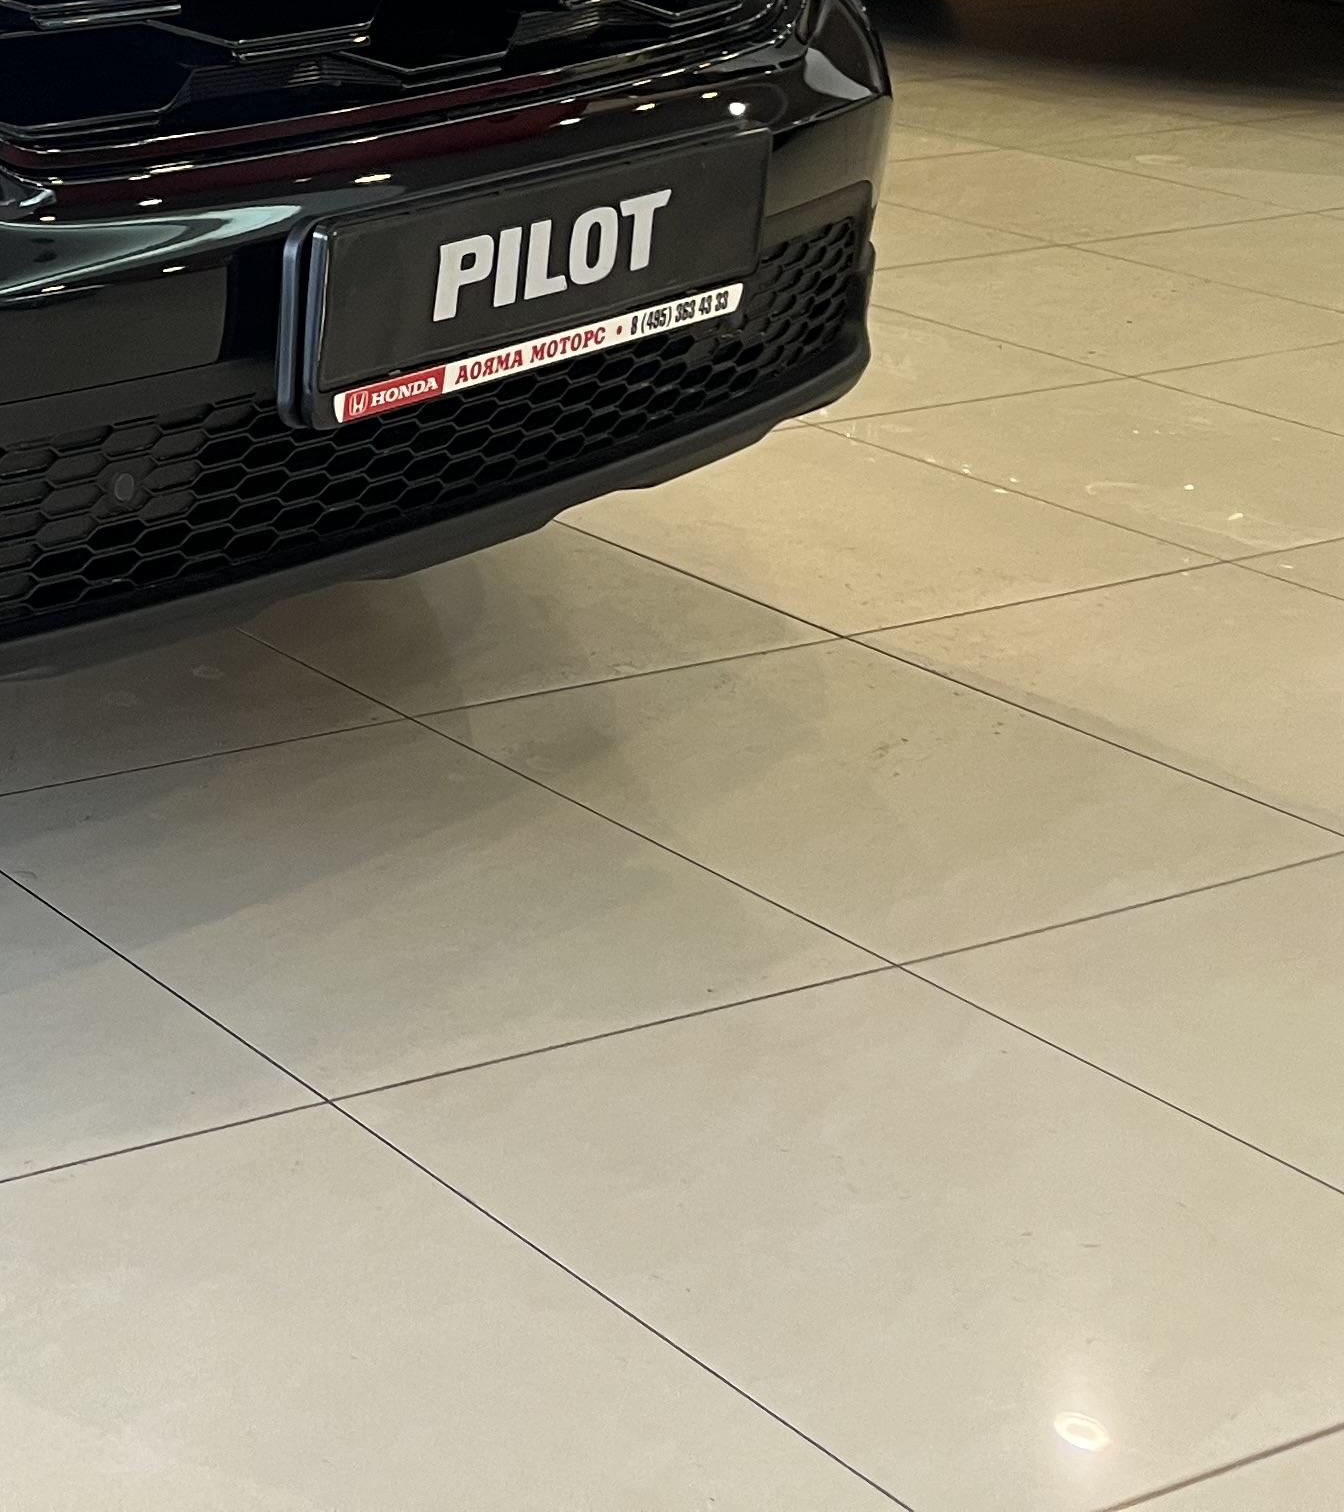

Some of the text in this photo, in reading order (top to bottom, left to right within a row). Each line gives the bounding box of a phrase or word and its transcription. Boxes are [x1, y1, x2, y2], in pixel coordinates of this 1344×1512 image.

[432, 188, 672, 323] PILOT
[454, 349, 524, 386] АОЯМА
[529, 326, 607, 364] МОТОРС
[630, 315, 639, 336] 8
[640, 305, 673, 335] (495)
[698, 294, 713, 316] 43
[715, 290, 729, 312] 33
[370, 377, 439, 408] HONDA
